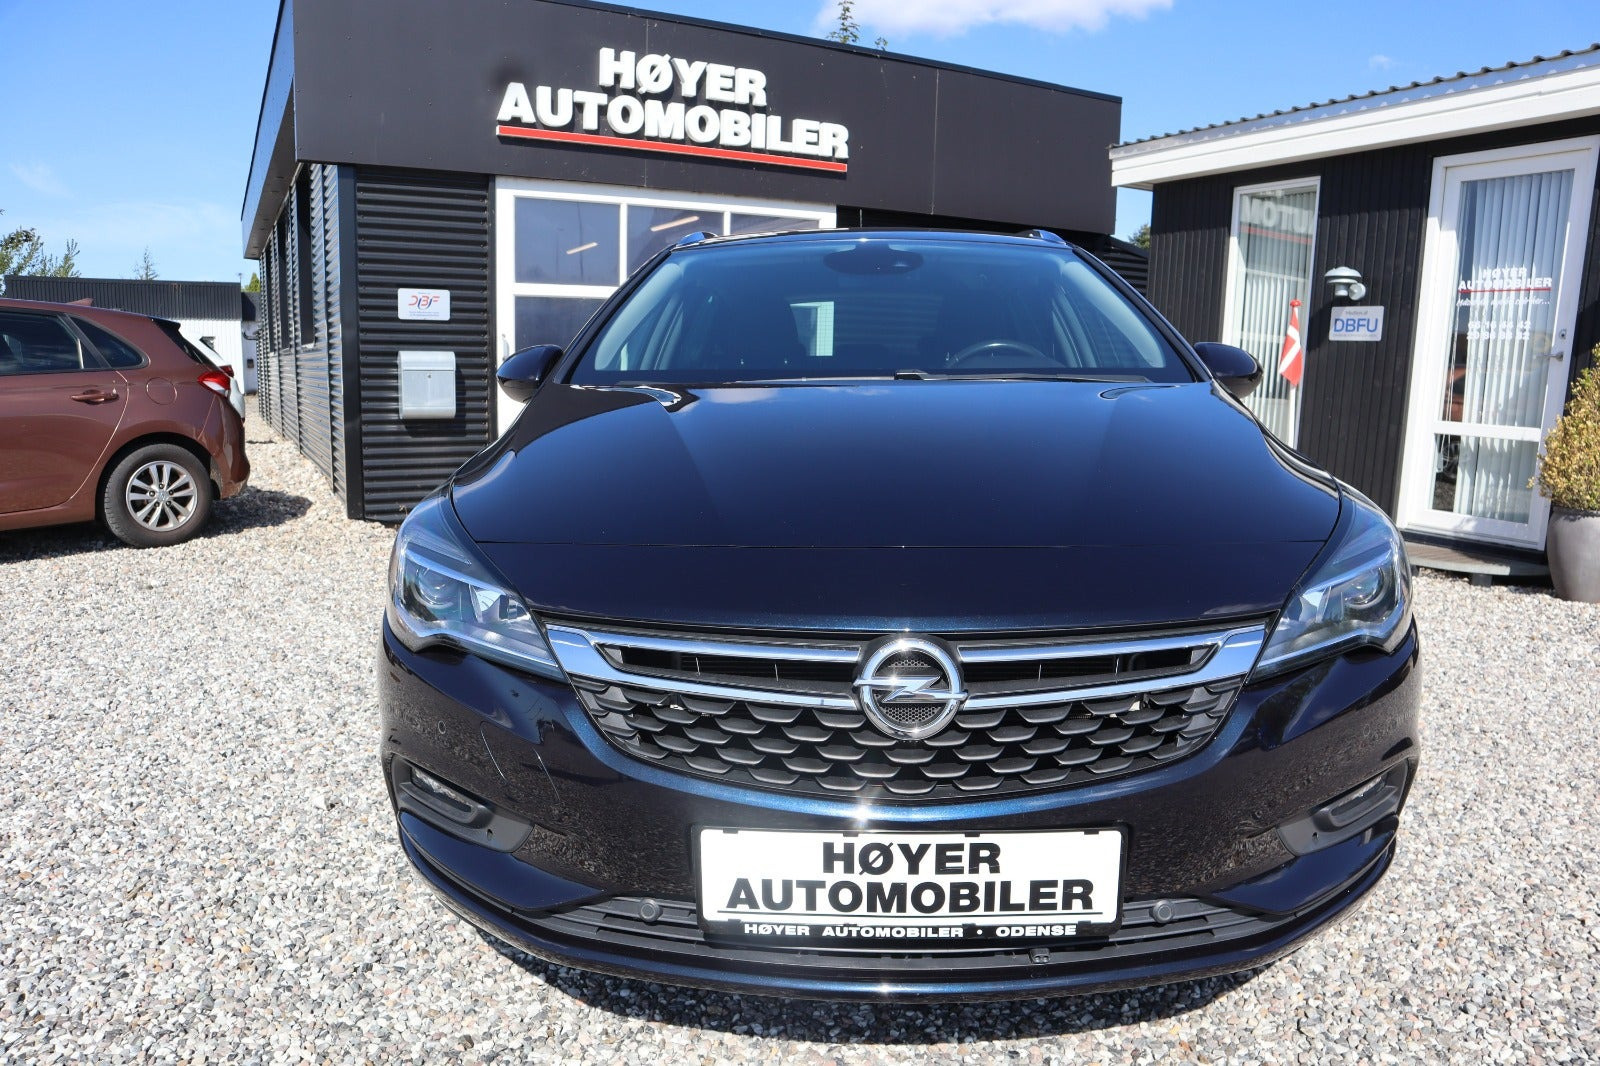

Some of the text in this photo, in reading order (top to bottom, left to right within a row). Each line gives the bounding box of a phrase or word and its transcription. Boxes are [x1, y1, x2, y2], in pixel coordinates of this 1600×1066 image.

[598, 47, 767, 107] HØYER
[496, 82, 850, 159] AUTOMOBILER
[1458, 277, 1552, 290] AUTOMOBILER
[1333, 318, 1378, 333] DBFU
[822, 842, 1001, 876] HØYER
[725, 878, 1093, 913] AUTOMOBILER
[743, 923, 1077, 938] HØYER AUTOMOBILER ODENSE
